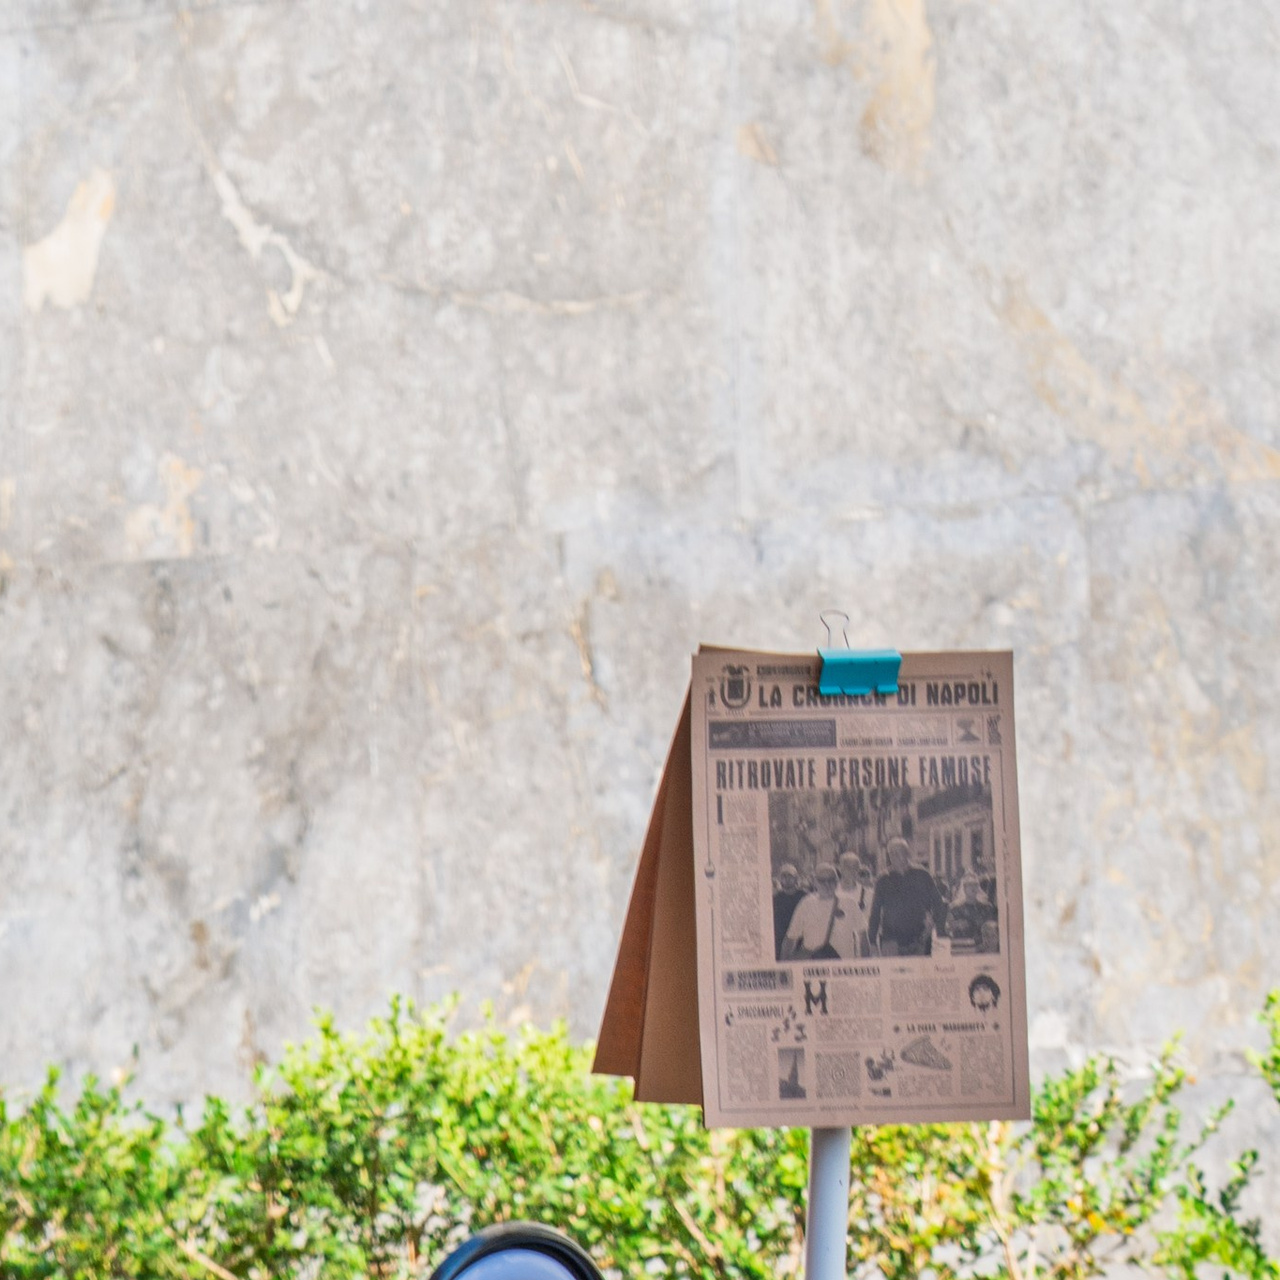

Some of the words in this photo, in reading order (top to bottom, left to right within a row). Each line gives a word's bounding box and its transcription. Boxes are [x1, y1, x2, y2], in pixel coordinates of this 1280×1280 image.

[759, 684, 782, 707] LA
[897, 683, 915, 706] DI
[926, 681, 999, 706] NAPOLI
[716, 759, 815, 789] RITROVATE
[826, 757, 909, 787] PERSONE
[920, 755, 991, 785] FAMOSE
[804, 980, 828, 1015] M
